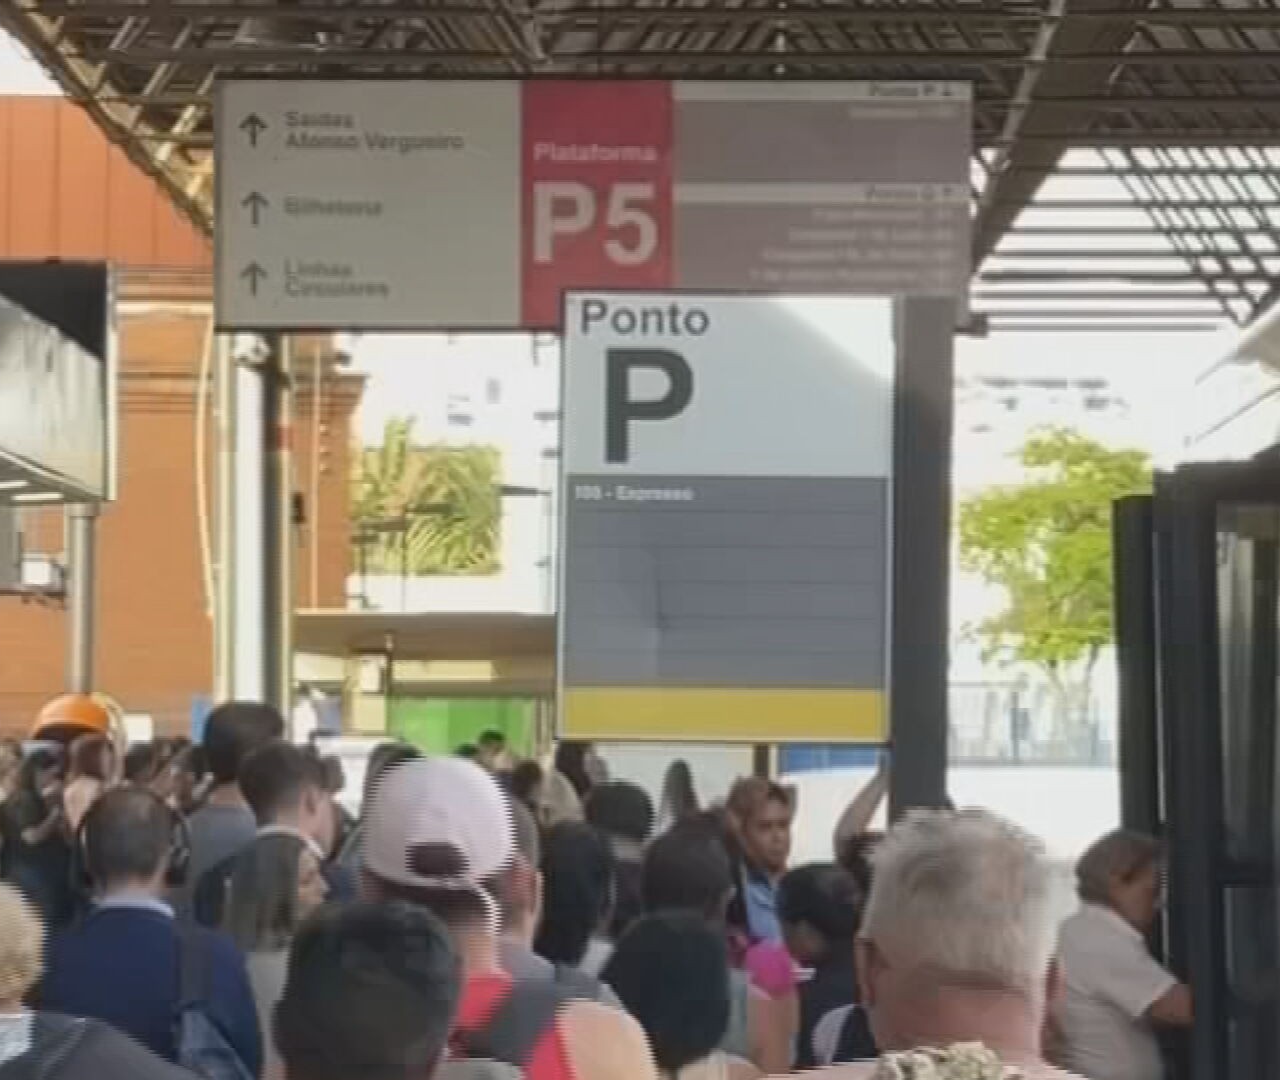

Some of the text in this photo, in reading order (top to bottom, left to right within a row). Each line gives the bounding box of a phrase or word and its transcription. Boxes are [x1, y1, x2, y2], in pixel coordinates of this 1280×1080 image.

[534, 142, 657, 162] Plataforma
[534, 182, 658, 264] P5
[581, 299, 710, 336] Ponto
[604, 347, 694, 464] P
